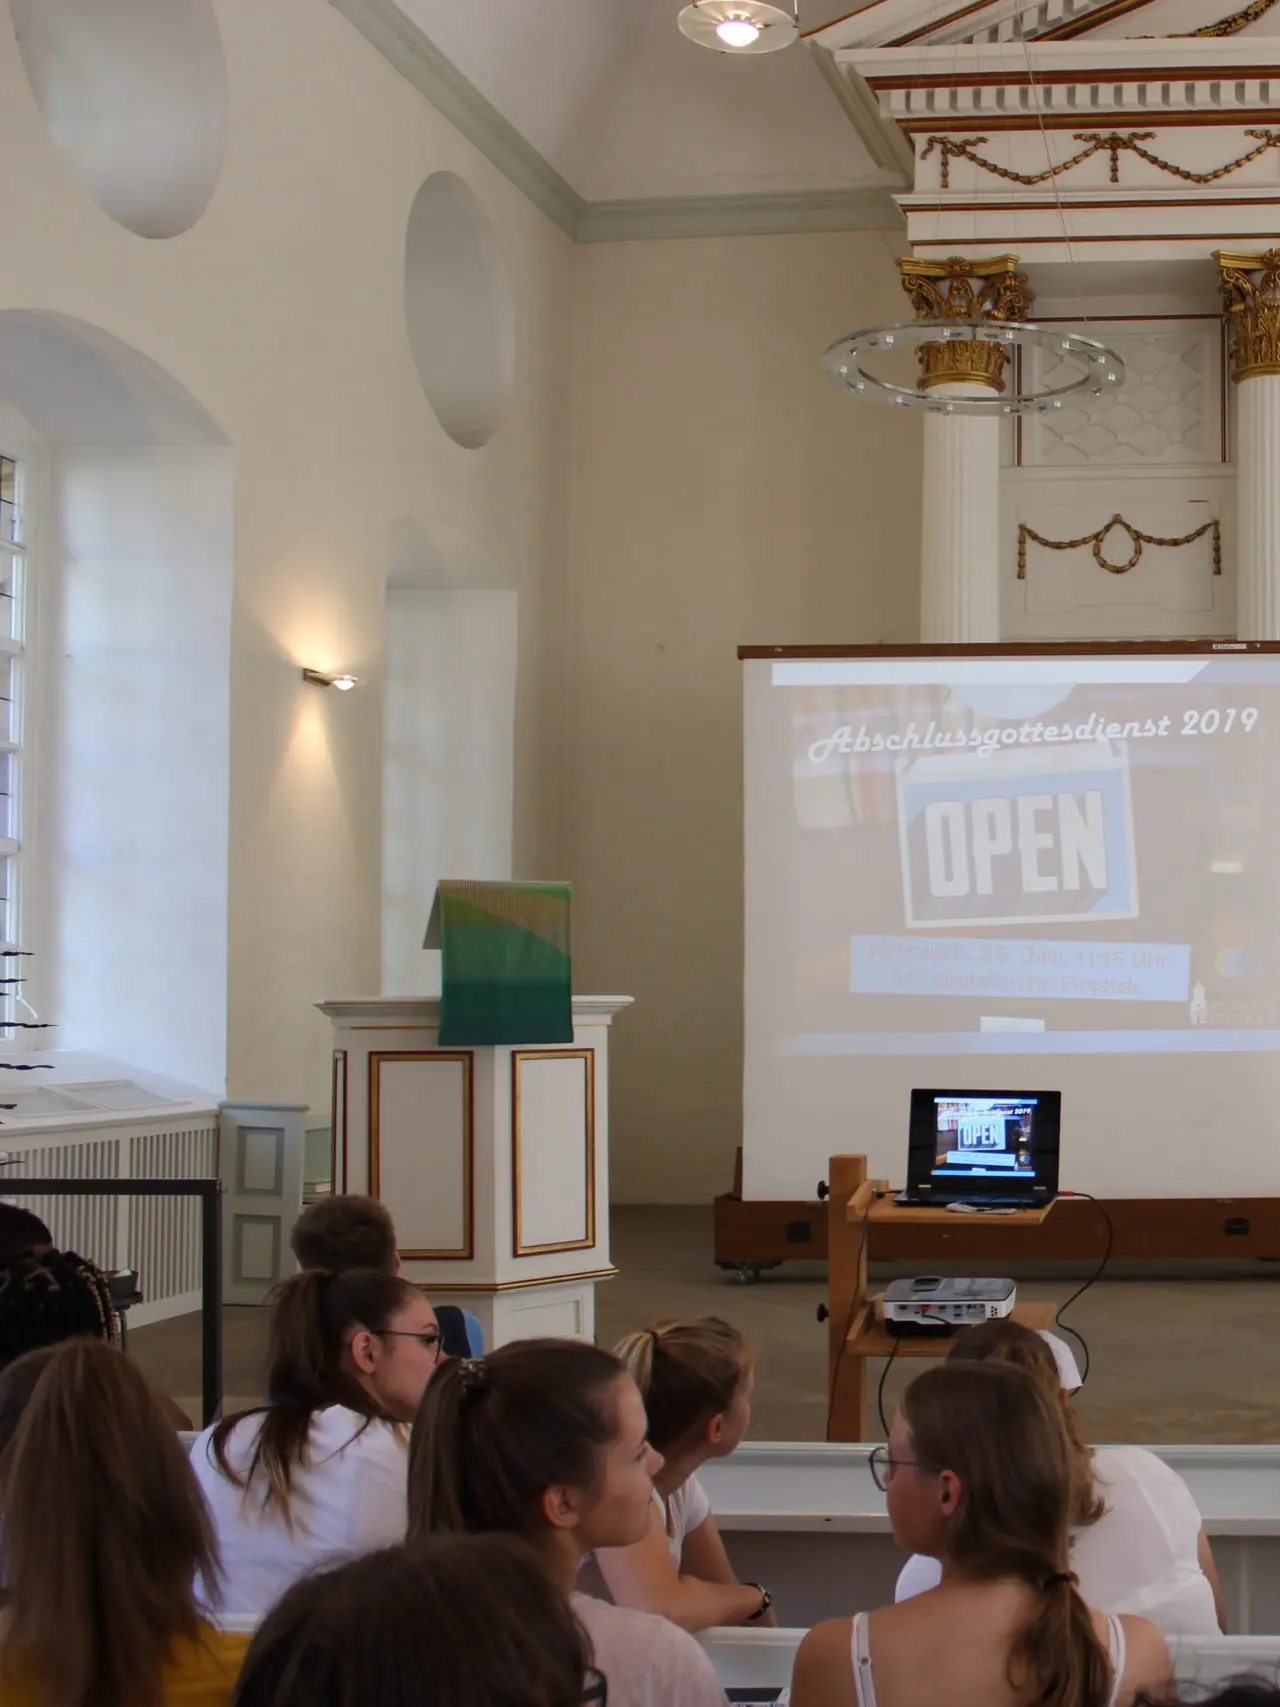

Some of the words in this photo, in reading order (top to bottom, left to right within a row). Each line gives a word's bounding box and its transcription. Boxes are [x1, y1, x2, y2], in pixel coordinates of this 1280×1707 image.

[808, 712, 1171, 763] Abschlussgottesdienst
[1180, 707, 1259, 735] 2019
[924, 788, 1107, 897] OPEN
[1131, 949, 1168, 970] Uhr
[1060, 970, 1143, 996] Diepholz
[963, 1125, 999, 1145] OPEN
